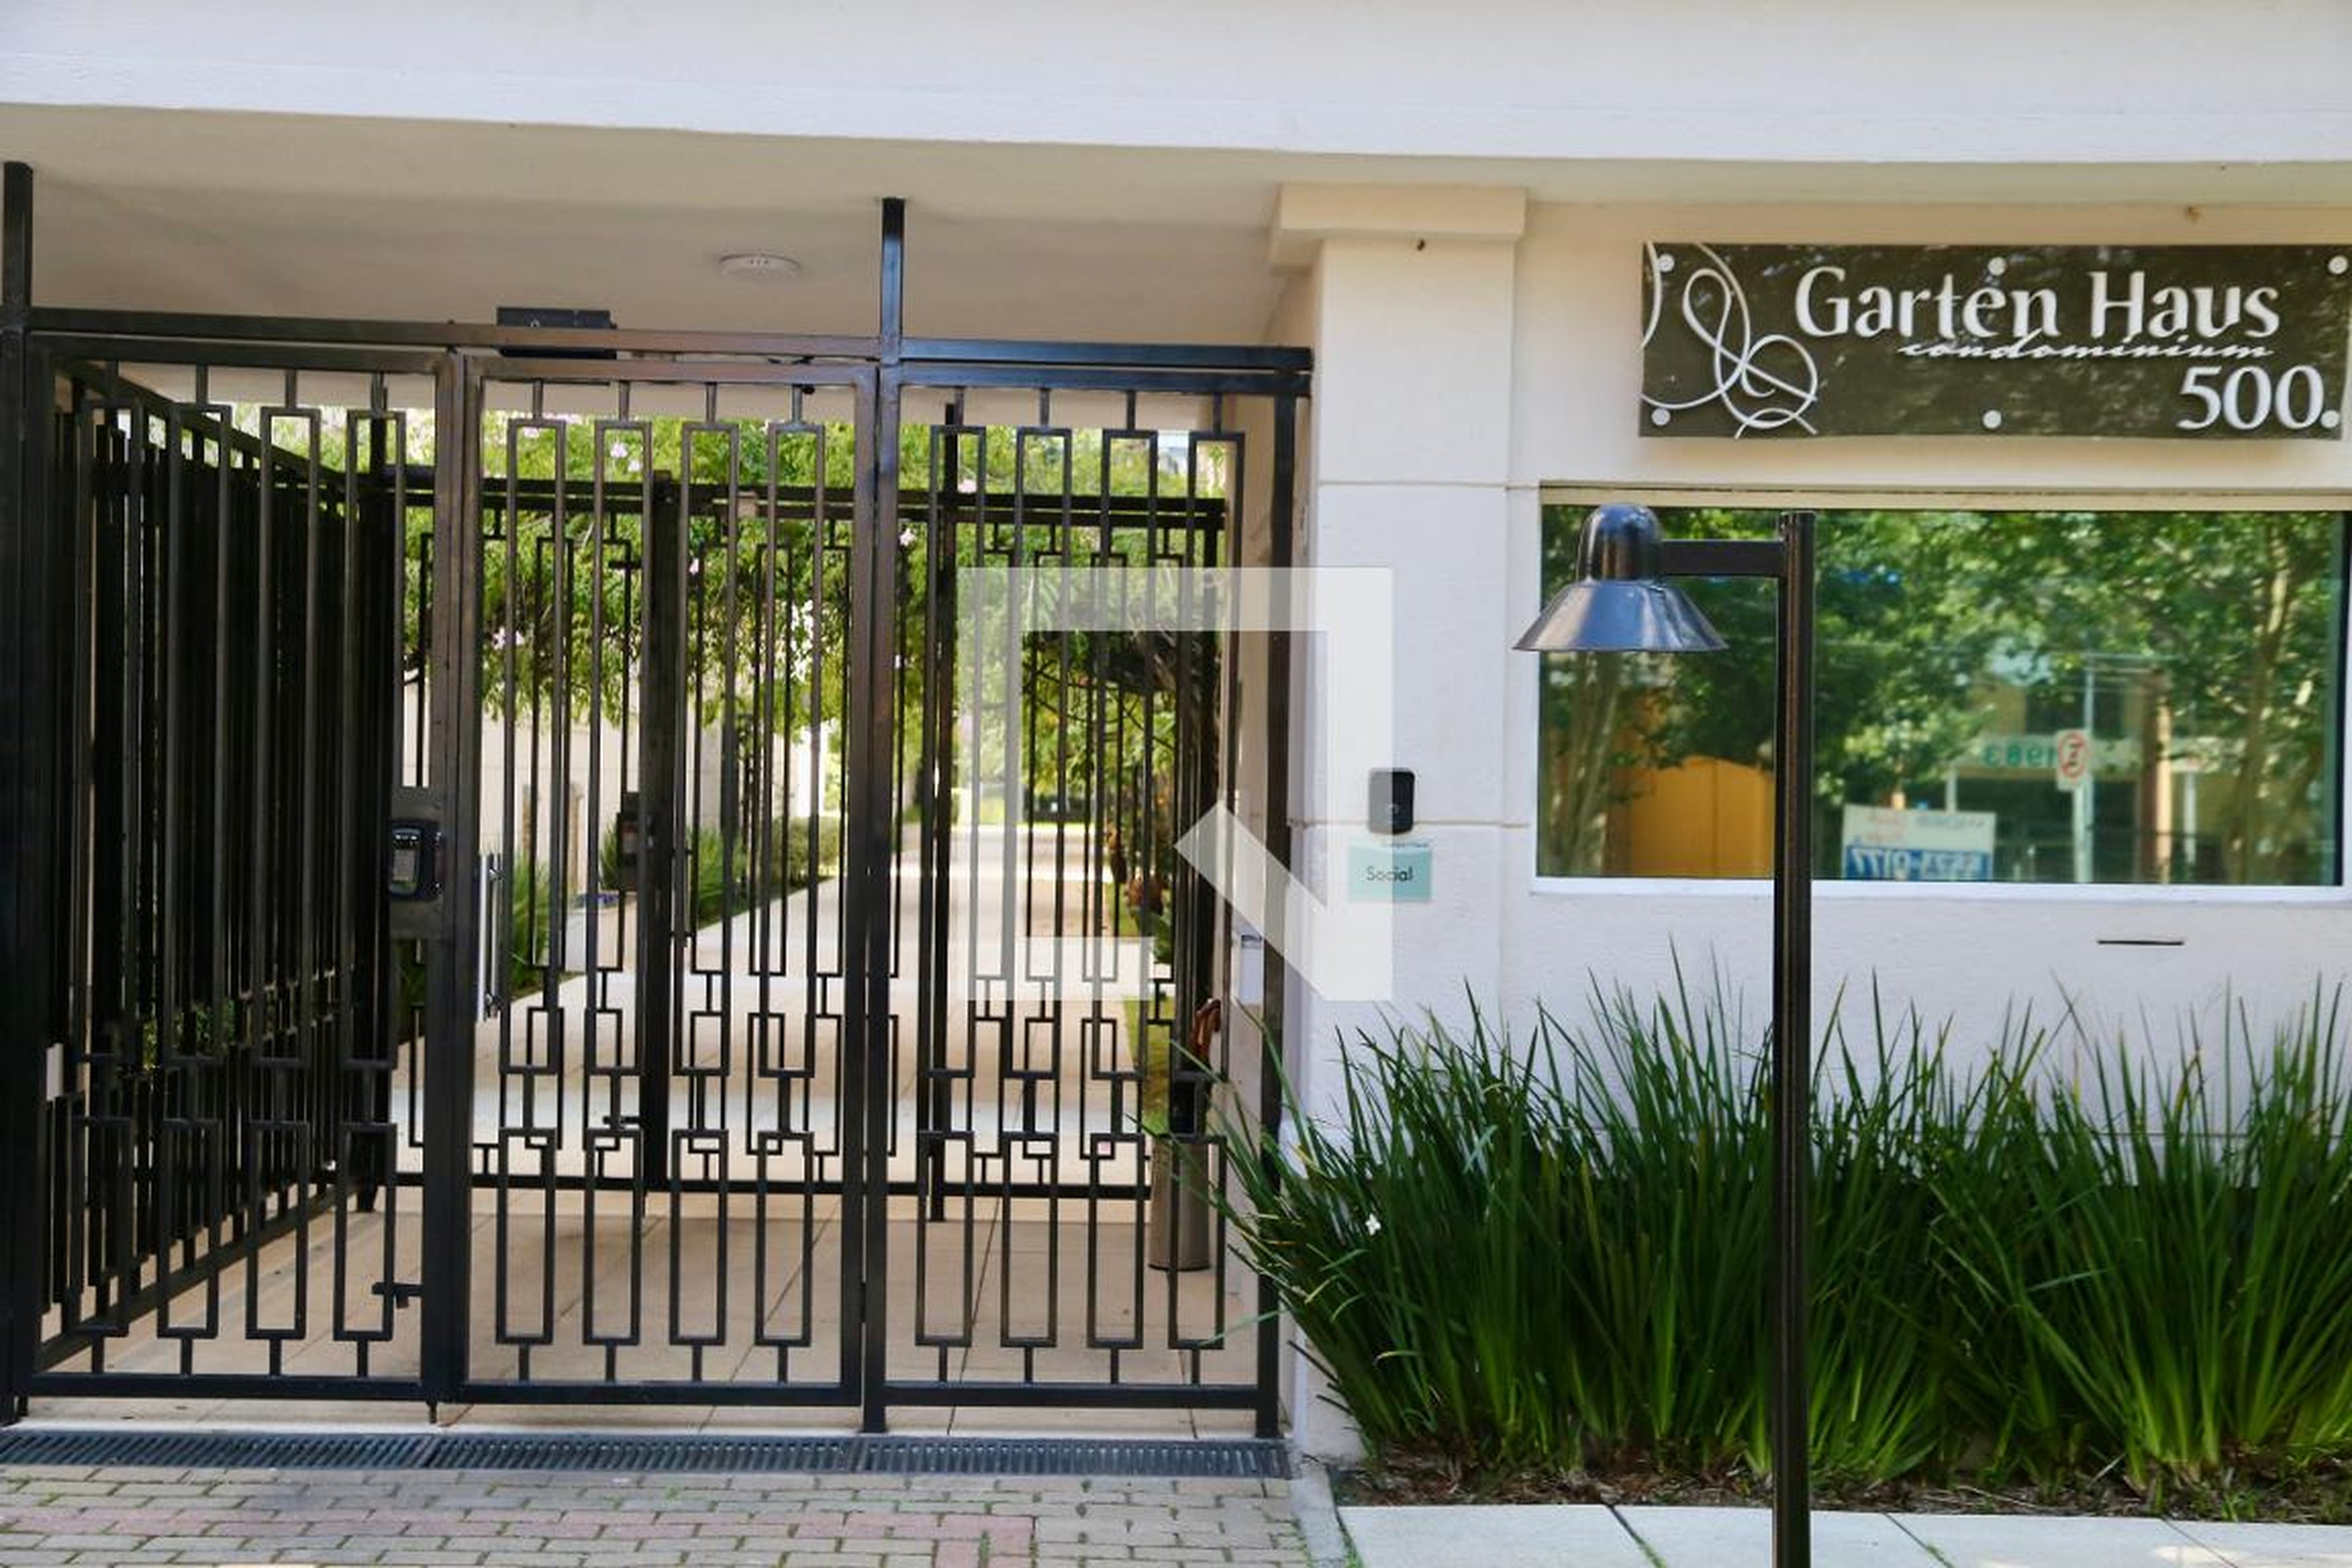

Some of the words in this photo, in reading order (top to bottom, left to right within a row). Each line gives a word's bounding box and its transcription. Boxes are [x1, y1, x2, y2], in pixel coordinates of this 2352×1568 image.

[1795, 266, 2060, 339] Garten
[2087, 270, 2280, 339] Haus
[1898, 328, 2274, 359] condominium
[2176, 365, 2325, 430] 500
[1366, 865, 1414, 882] Social
